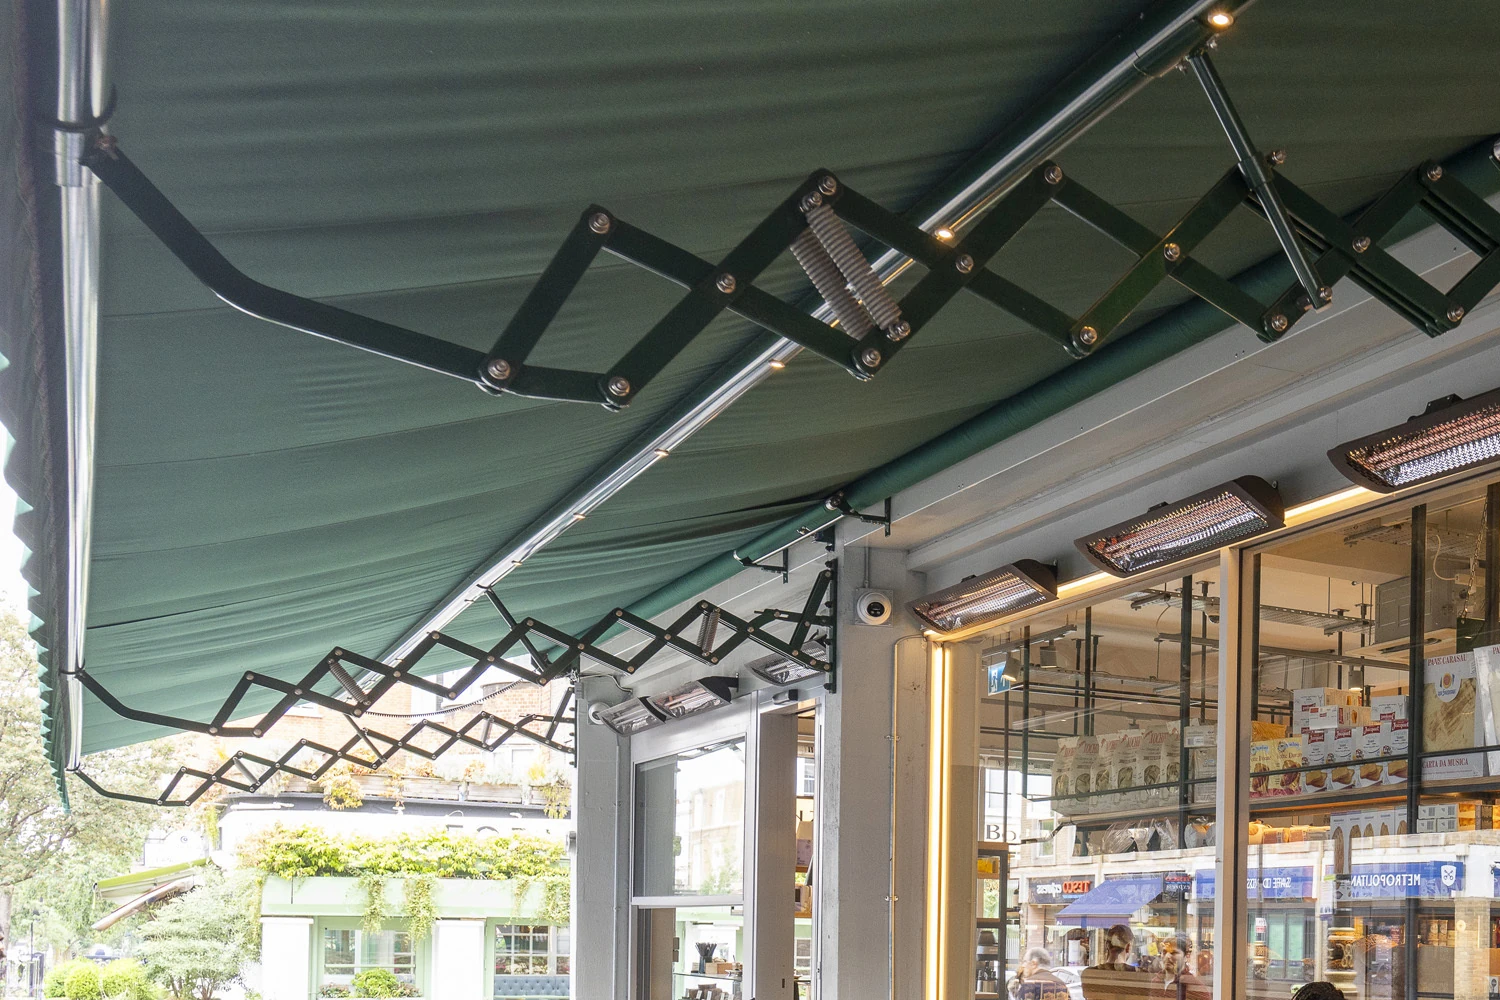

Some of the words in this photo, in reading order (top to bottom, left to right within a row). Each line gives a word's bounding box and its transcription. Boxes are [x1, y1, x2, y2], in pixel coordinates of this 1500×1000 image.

[1427, 656, 1442, 666] PANE
[1441, 654, 1468, 665] CARASAU
[1422, 758, 1438, 768] CARTA
[1448, 757, 1468, 767] MUSICA
